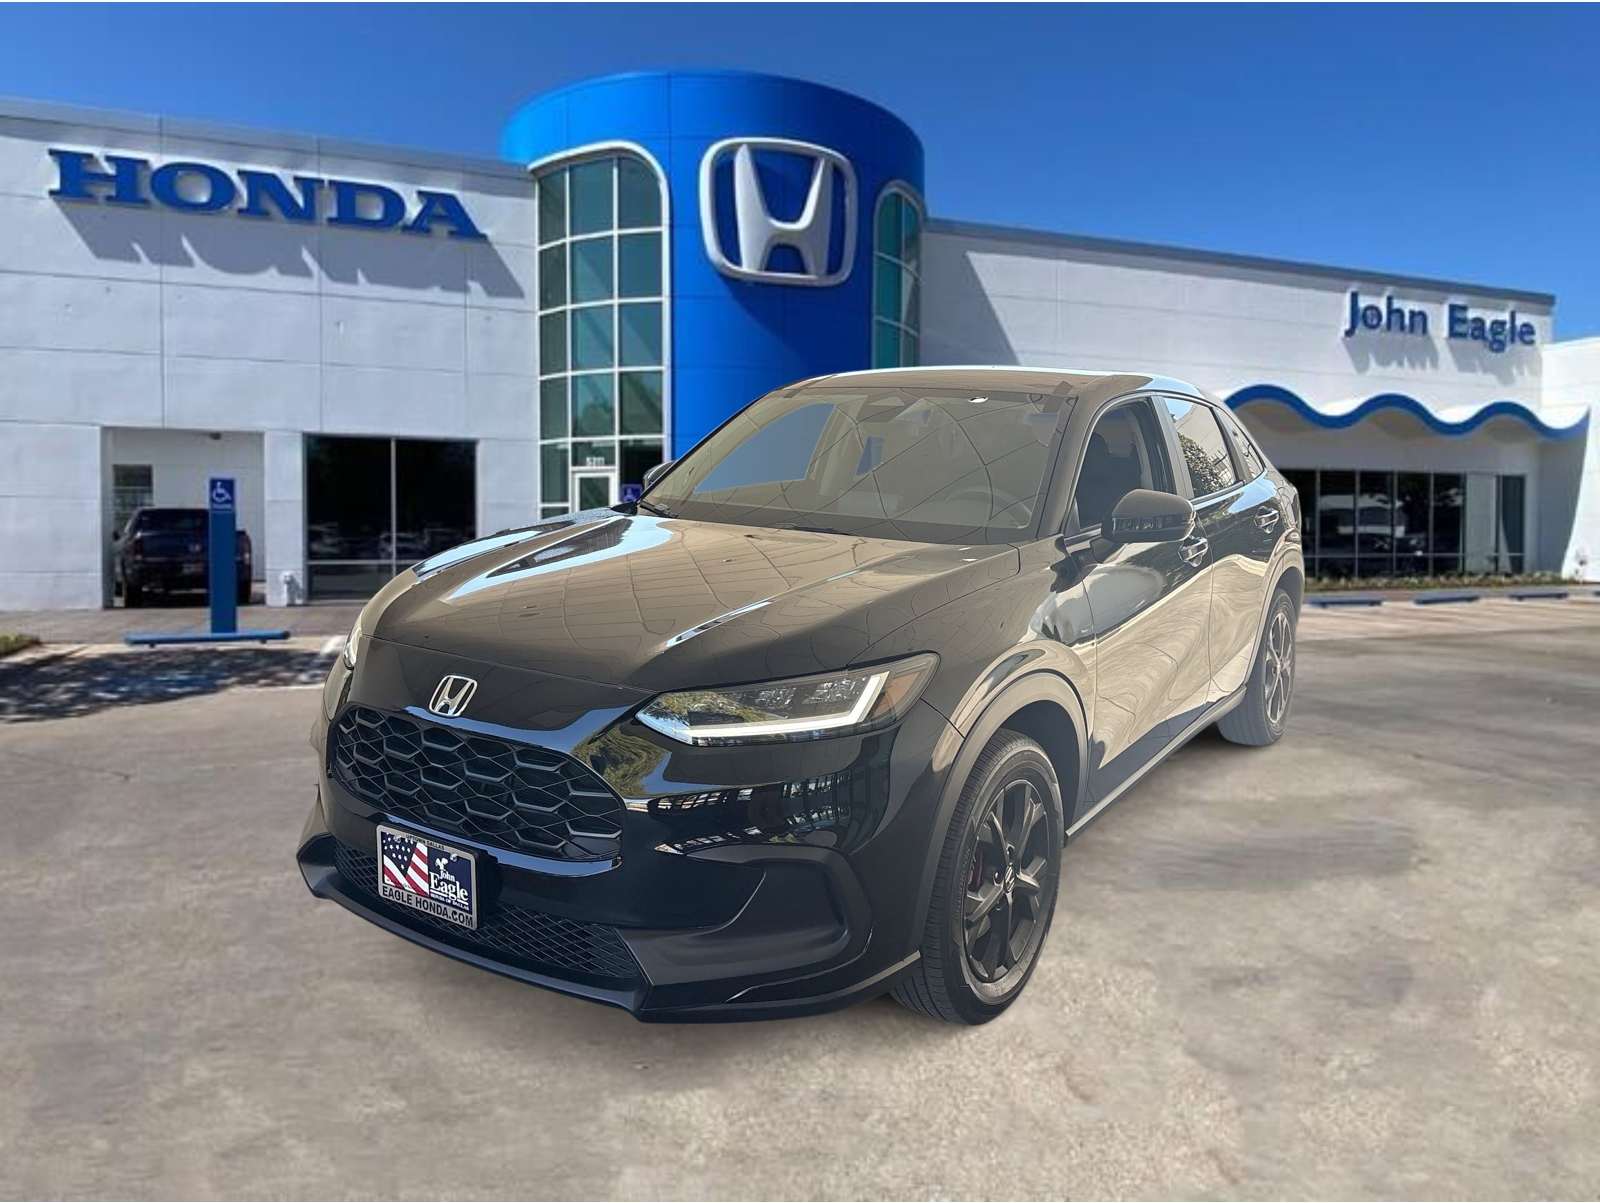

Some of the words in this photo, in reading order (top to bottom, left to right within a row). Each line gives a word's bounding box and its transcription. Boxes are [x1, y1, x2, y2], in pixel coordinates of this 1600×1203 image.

[48, 148, 488, 241] HONDA
[1344, 291, 1428, 338] John
[1447, 303, 1536, 353] Eagle
[429, 872, 469, 901] Eagle
[439, 871, 455, 882] John
[382, 886, 413, 906] EAGLE
[415, 897, 473, 928] HONDA.COM
